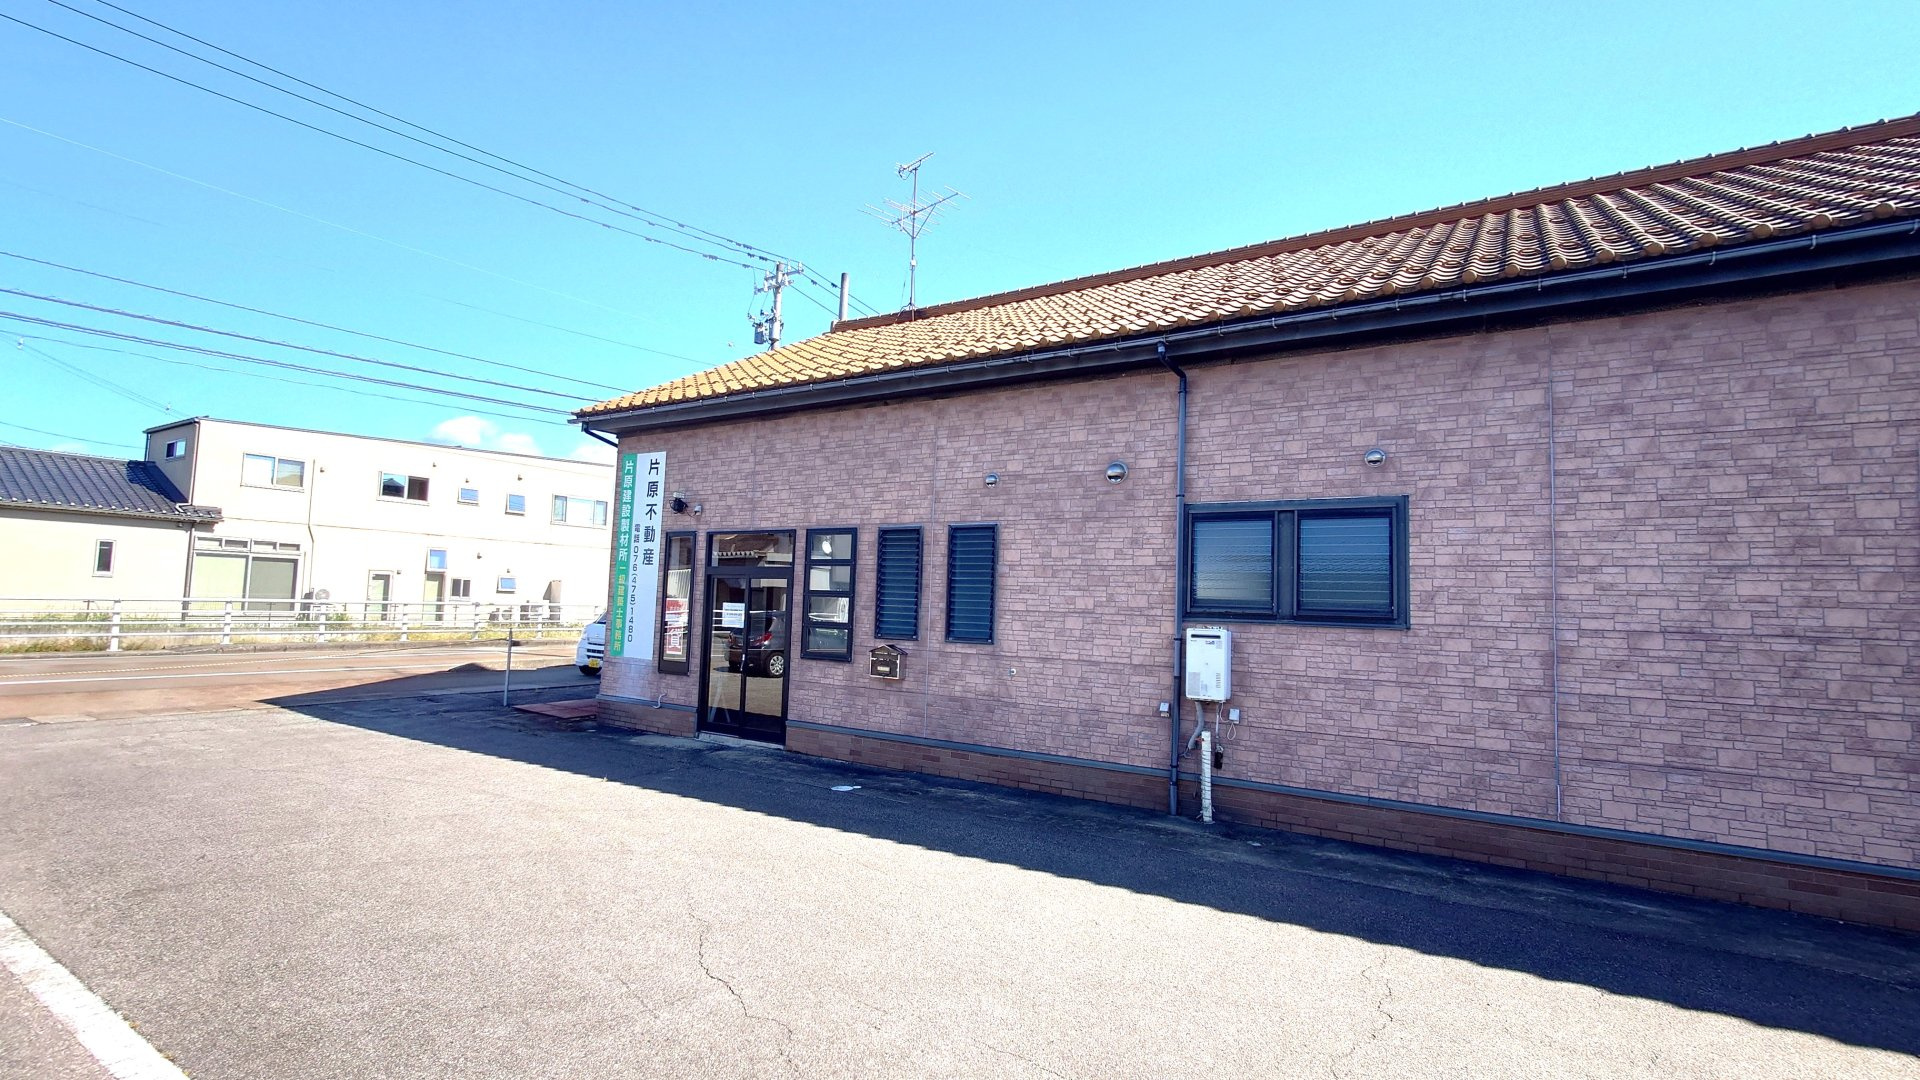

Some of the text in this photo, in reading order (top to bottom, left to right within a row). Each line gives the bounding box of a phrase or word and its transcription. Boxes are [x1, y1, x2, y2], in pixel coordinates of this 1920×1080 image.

[642, 458, 660, 566] 片原不動産
